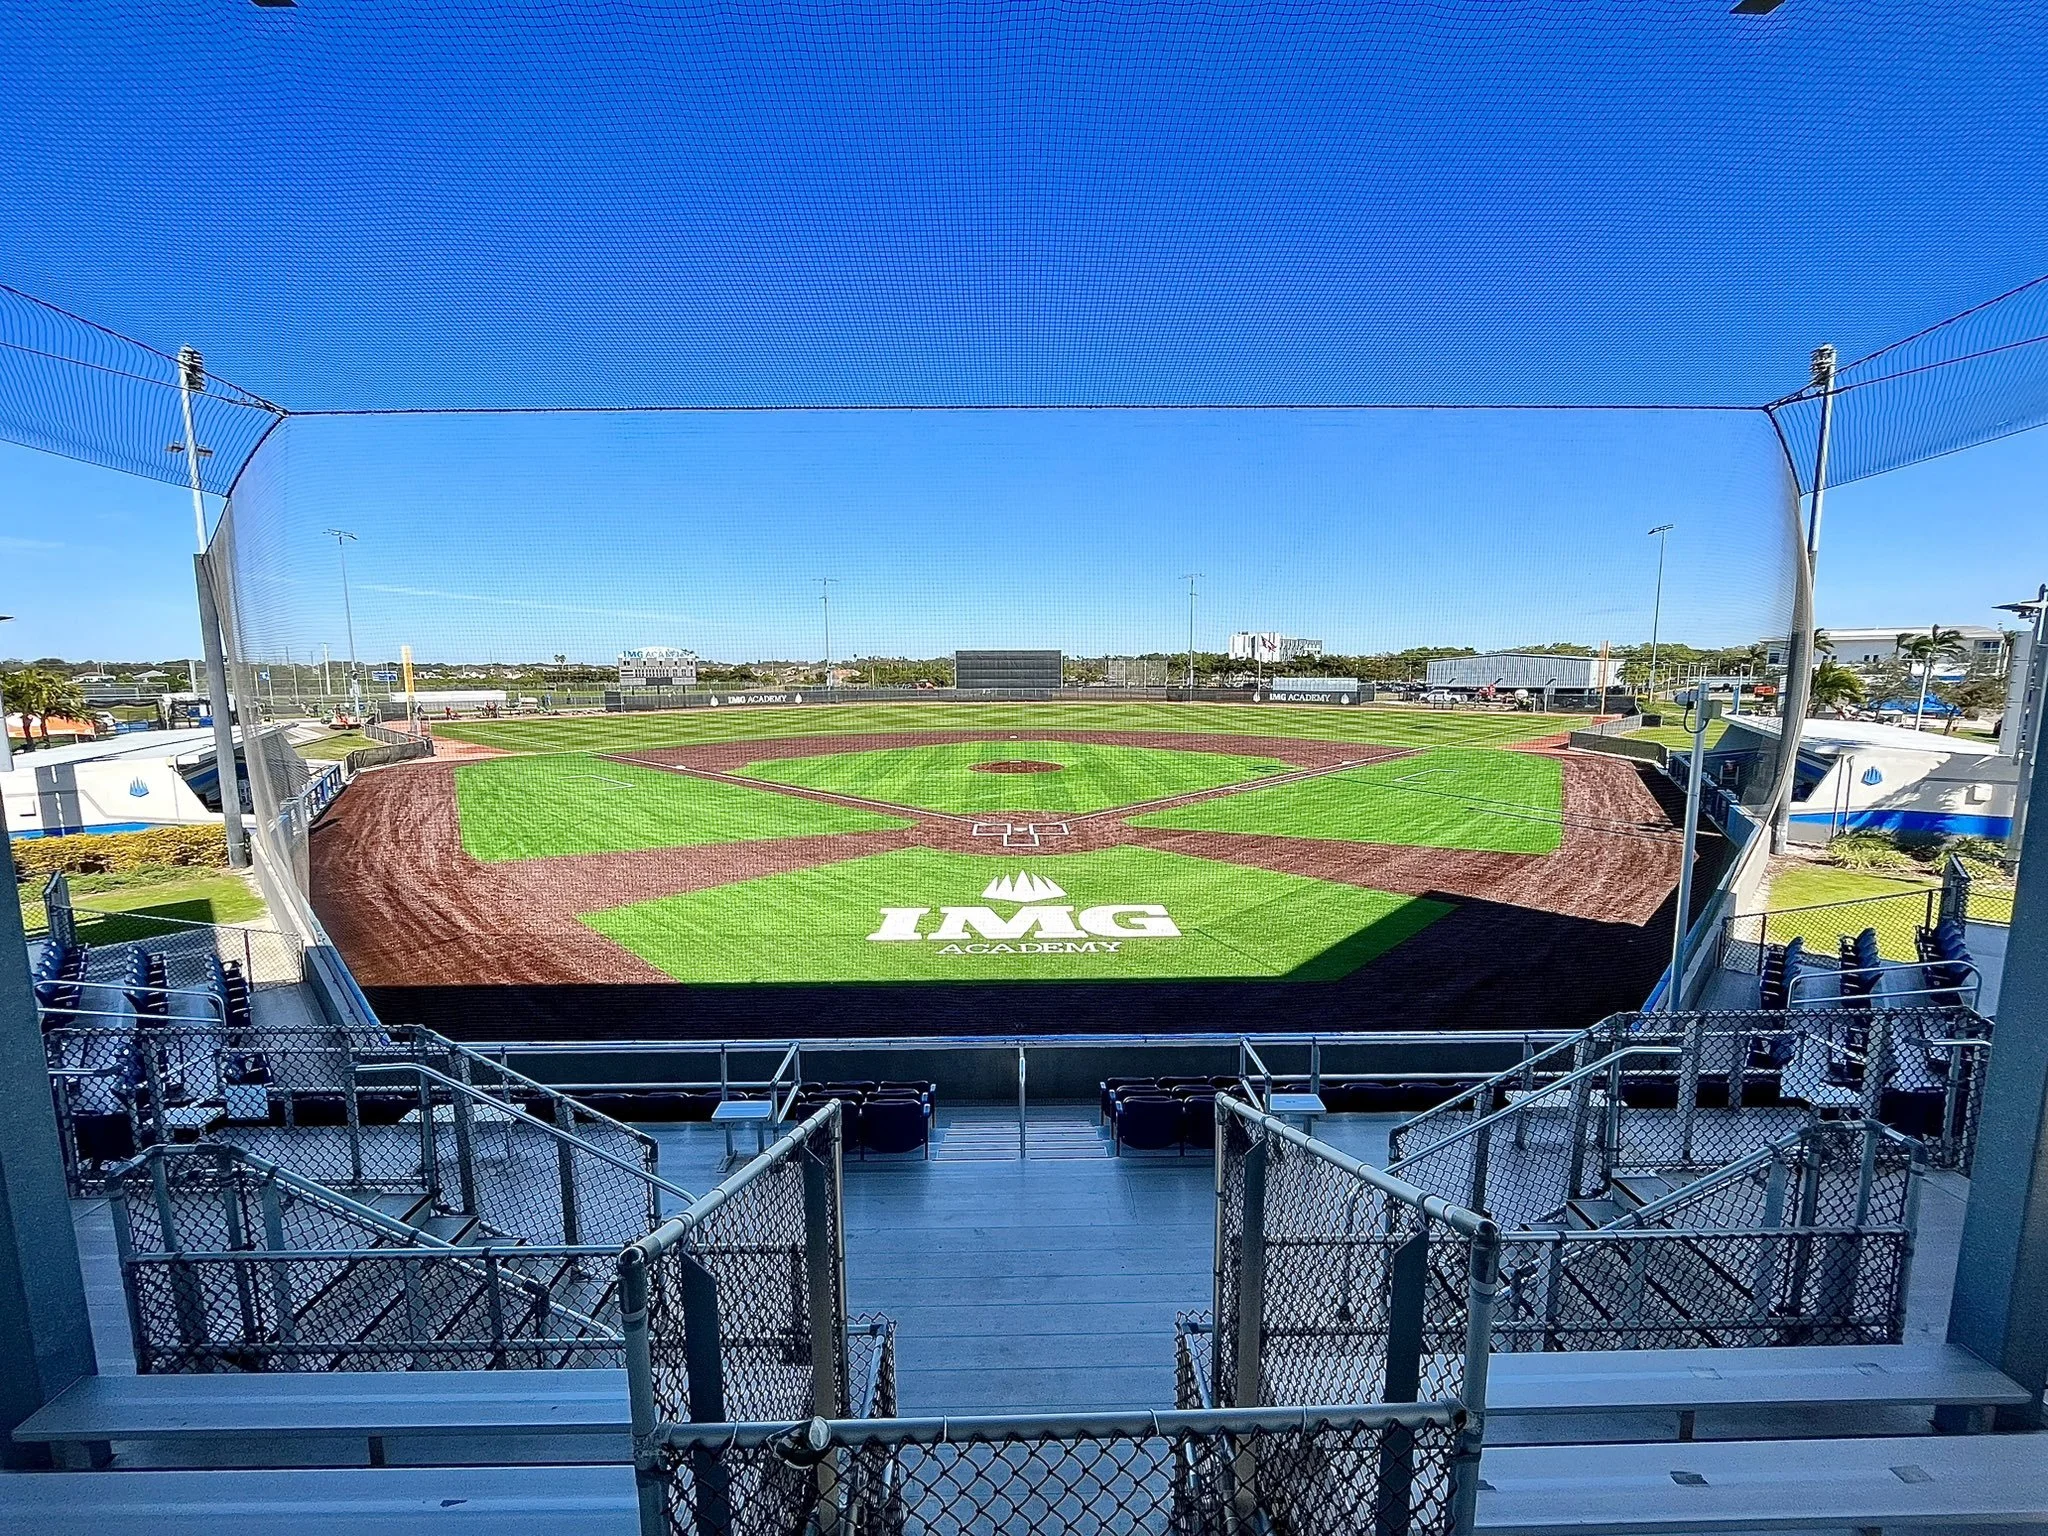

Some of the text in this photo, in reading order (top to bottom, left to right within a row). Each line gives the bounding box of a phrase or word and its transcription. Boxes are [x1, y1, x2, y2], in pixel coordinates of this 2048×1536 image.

[623, 650, 643, 658] IMG
[727, 695, 787, 704] IMG ACADEMY
[1269, 693, 1331, 702] IMG ACADEMY
[865, 904, 1183, 941] IMG
[935, 941, 1123, 954] ACADEMY
